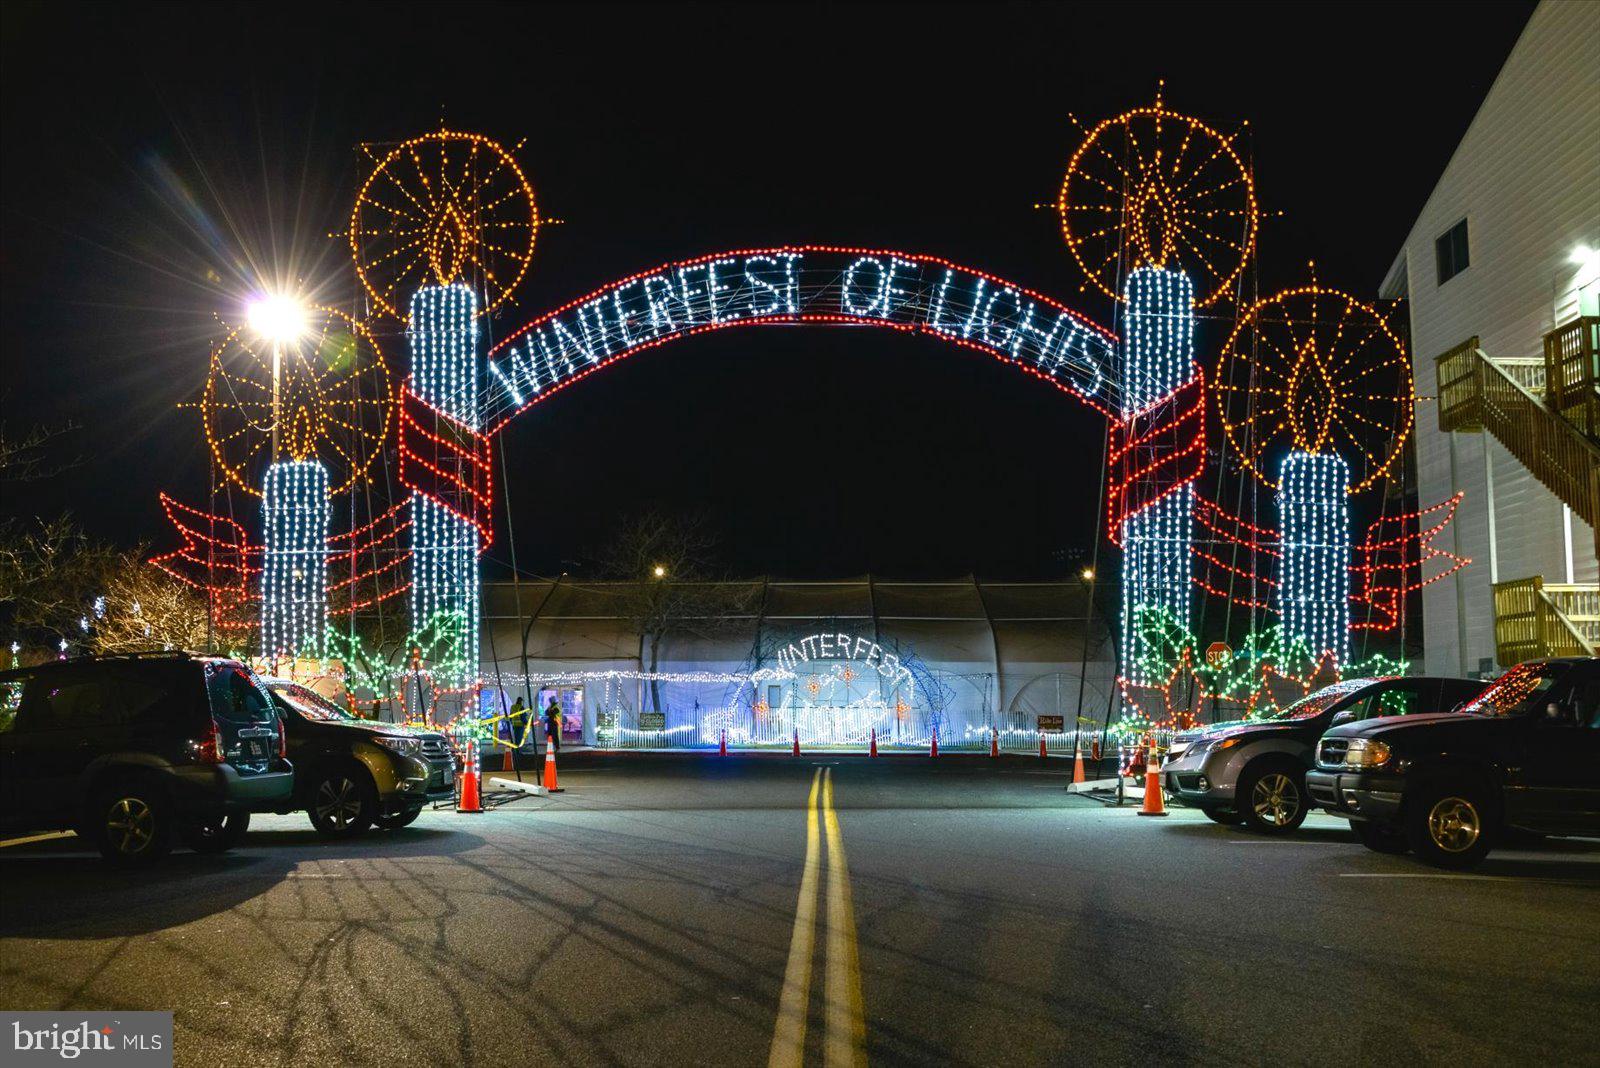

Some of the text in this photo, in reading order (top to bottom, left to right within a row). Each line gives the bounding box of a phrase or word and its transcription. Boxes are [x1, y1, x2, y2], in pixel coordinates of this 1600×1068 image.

[489, 253, 1114, 405] WINTERFEST OF LIGHTS
[1208, 651, 1230, 662] STO
